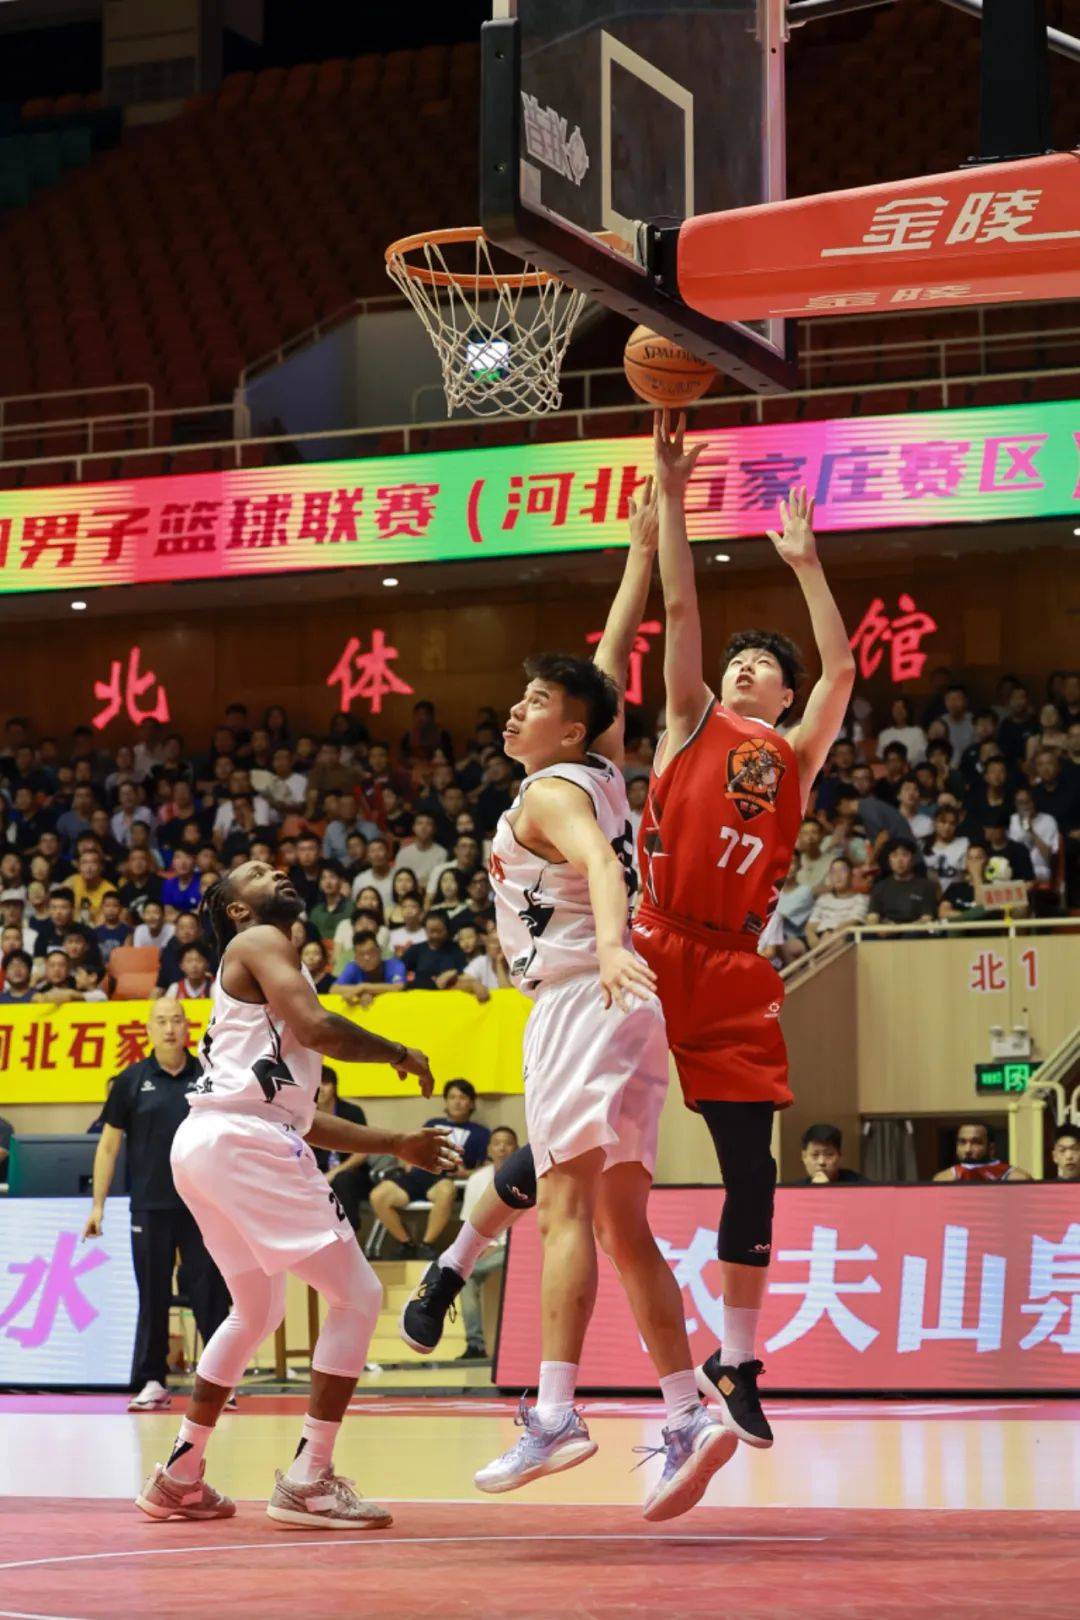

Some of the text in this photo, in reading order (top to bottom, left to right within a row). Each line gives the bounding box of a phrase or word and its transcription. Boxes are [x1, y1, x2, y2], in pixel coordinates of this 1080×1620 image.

[821, 190, 1080, 257] 金陵
[716, 826, 764, 875] 77
[0, 1230, 110, 1349] 水
